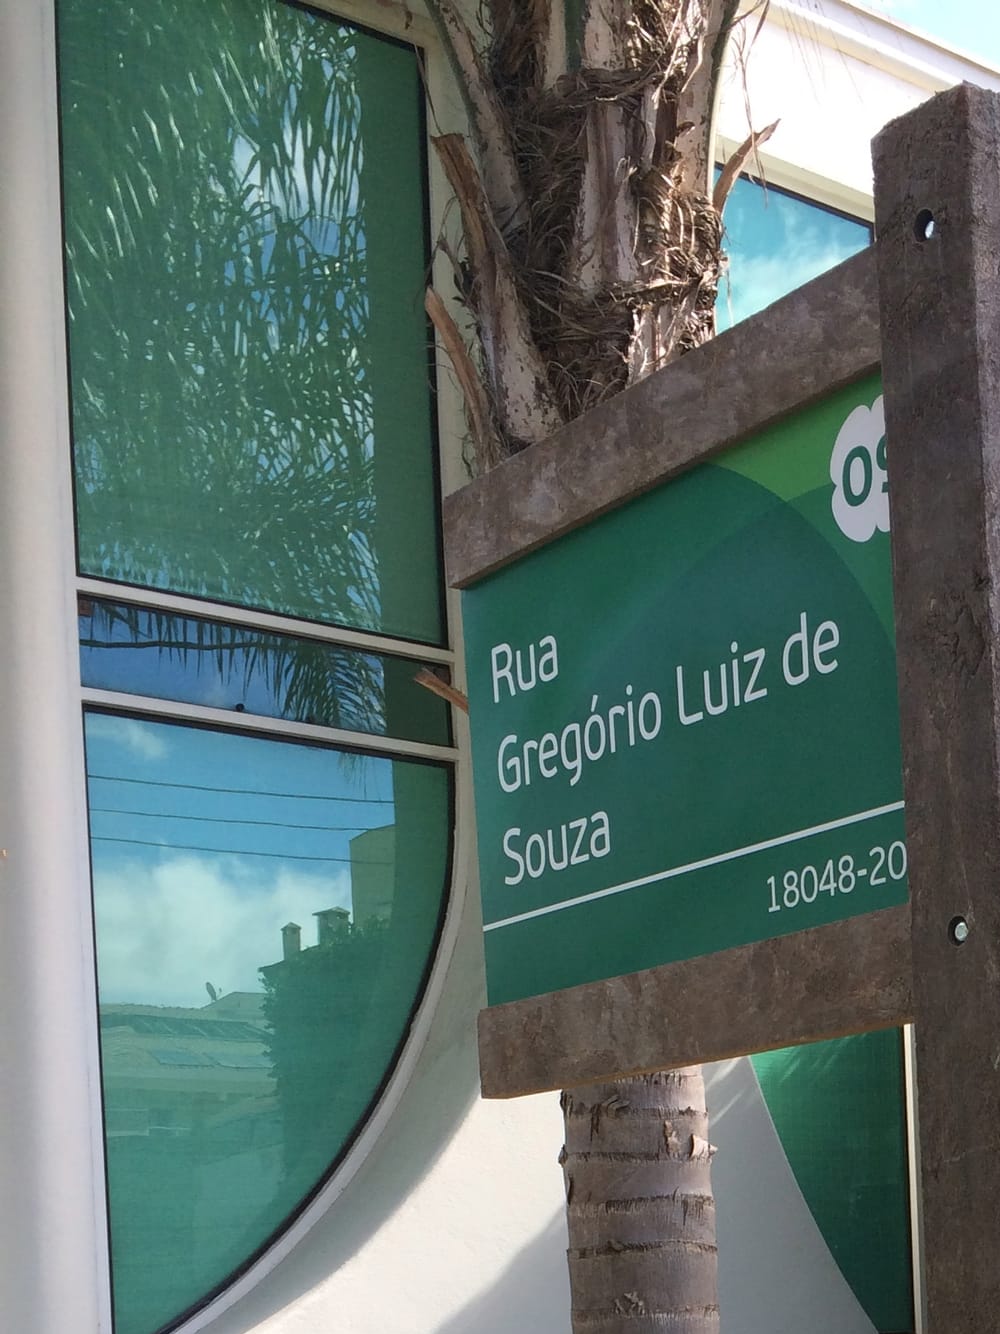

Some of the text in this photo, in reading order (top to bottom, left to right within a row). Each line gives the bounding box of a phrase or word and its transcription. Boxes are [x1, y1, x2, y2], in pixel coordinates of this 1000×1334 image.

[490, 634, 560, 704] Rua
[497, 611, 842, 793] Gregório Luiz de
[501, 810, 612, 887] Souza
[766, 840, 908, 913] 18048-20
